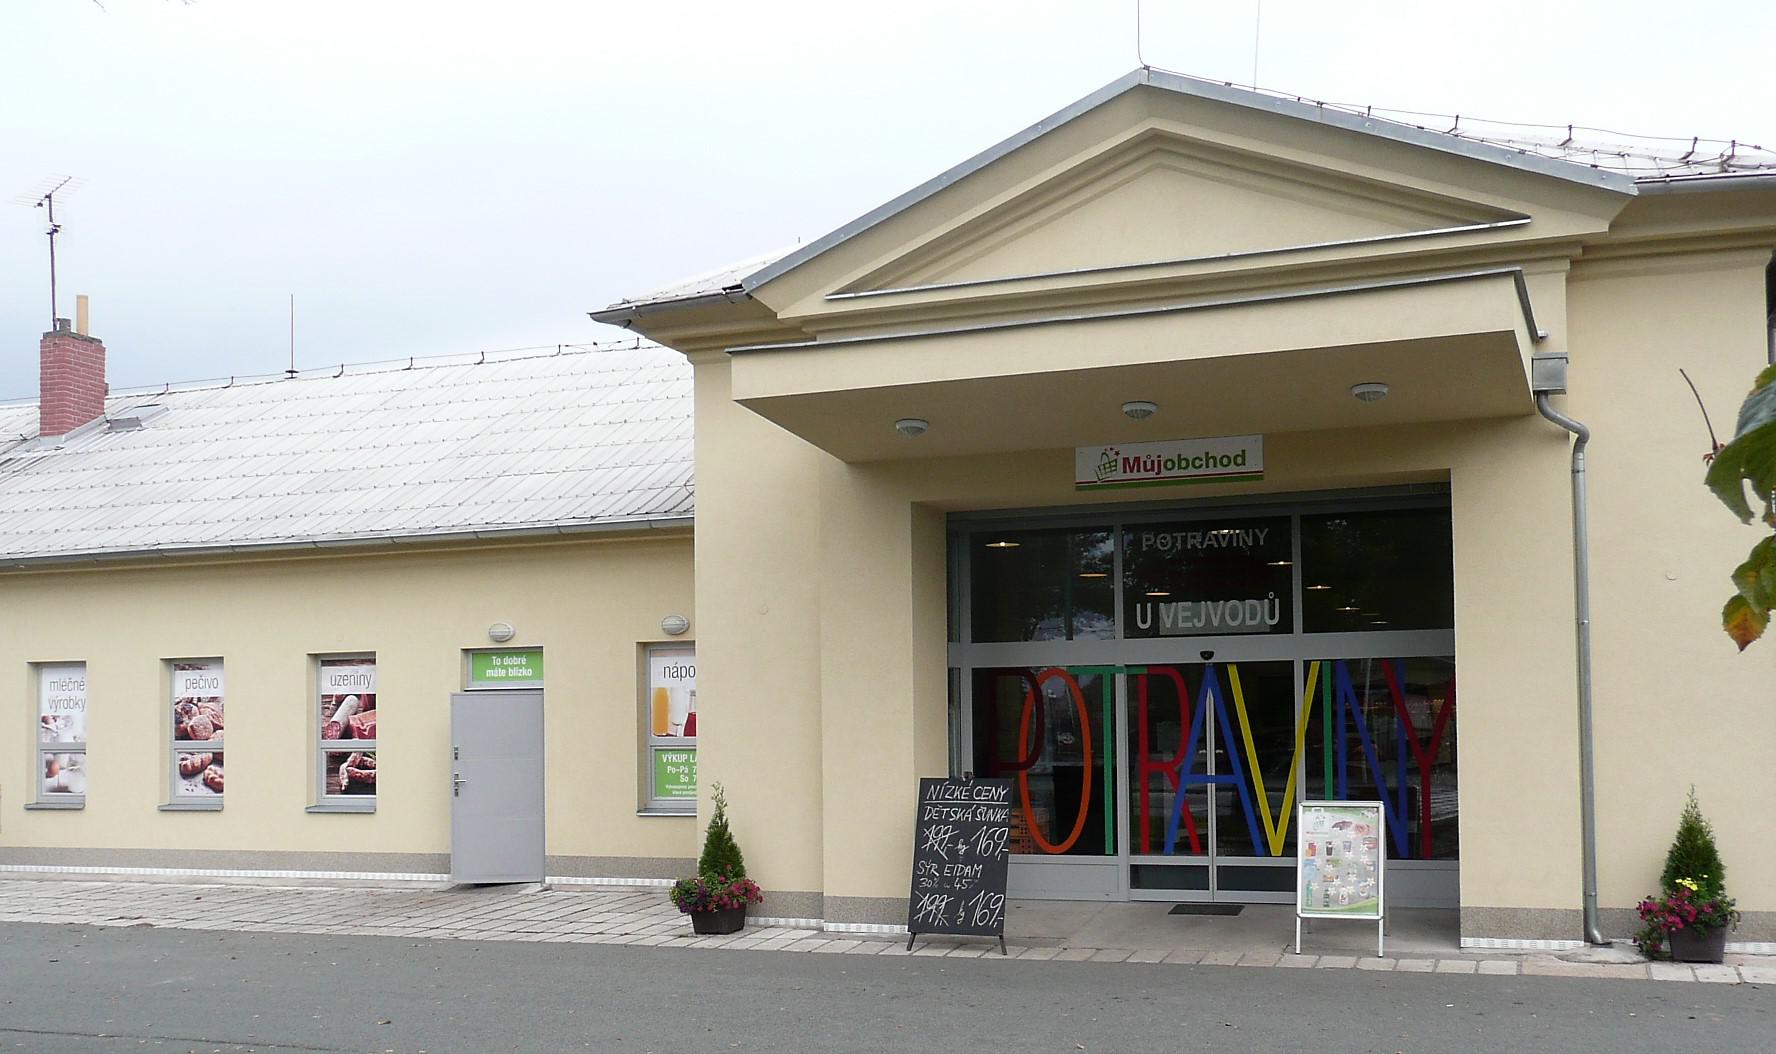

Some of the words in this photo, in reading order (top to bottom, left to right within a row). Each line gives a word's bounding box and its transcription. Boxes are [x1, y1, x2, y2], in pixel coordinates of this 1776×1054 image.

[1142, 527, 1269, 551] POTRAVINY
[1136, 602, 1152, 629] U
[1159, 591, 1280, 629] VEJVODŮ
[491, 655, 502, 666] To
[503, 655, 527, 666] dobré
[330, 671, 372, 689] uzeniny
[486, 666, 506, 677] máte
[508, 666, 533, 677] blízko
[663, 661, 696, 681] nápo
[185, 675, 219, 693] pečivo
[48, 695, 86, 713] výrobky
[662, 751, 688, 763] VÝKUP
[986, 660, 1456, 859] POTRAVINY
[680, 775, 689, 783] So
[926, 780, 973, 800] NÍZKÉ
[973, 784, 1008, 801] CENY
[924, 804, 975, 821] DĚTSKÁ
[975, 805, 1009, 823] ŠUNKA
[917, 859, 939, 877] SÝR
[943, 864, 982, 879] EIDAM
[969, 890, 1004, 928] 169,-
